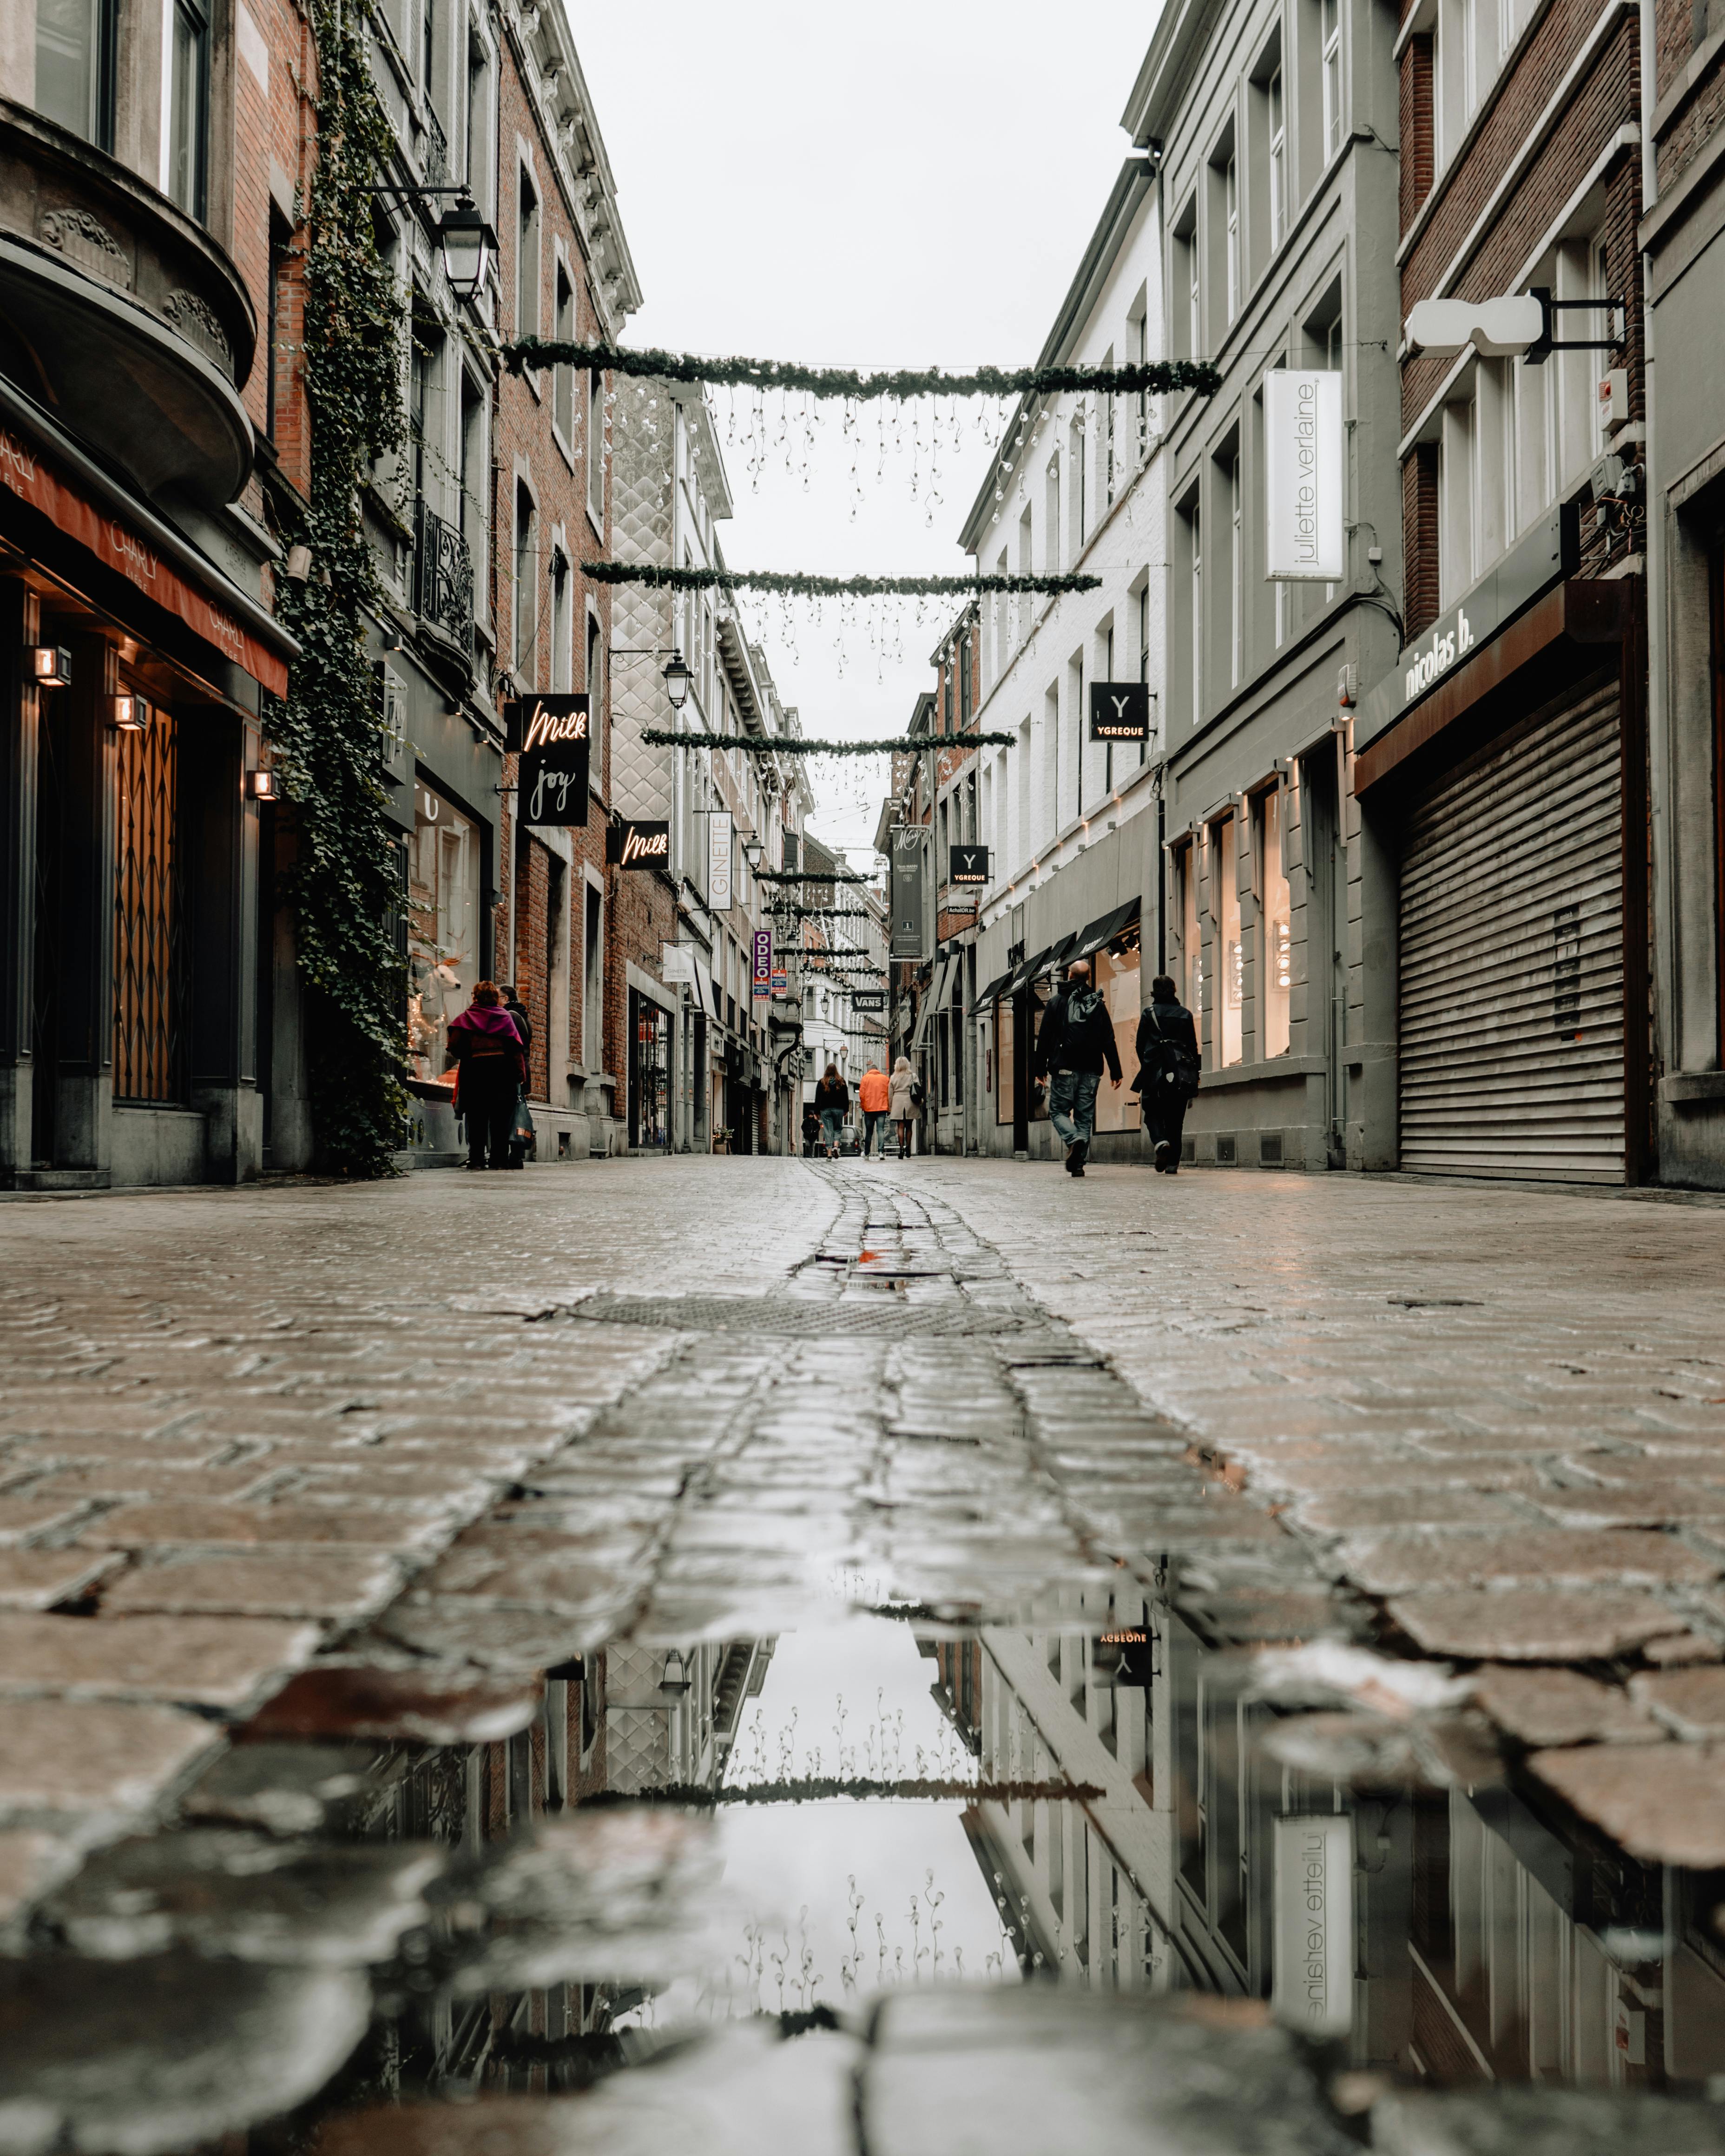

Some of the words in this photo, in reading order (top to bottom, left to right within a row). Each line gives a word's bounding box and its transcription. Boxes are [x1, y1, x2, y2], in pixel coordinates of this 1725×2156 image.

[1294, 384, 1314, 478] verlaine
[111, 520, 158, 580] CHARLY
[1294, 486, 1319, 565] juliette
[126, 567, 148, 594] LIEGE
[209, 601, 245, 650] CHARLY
[1406, 630, 1455, 701] nicolas
[1458, 608, 1474, 654] b.
[1097, 726, 1144, 736] YGREQUE
[1111, 696, 1130, 717] Y
[530, 759, 576, 820] joy
[712, 819, 728, 895] GINETTE
[963, 854, 976, 869] Y
[757, 933, 769, 978] ODEO
[855, 997, 881, 1007] VANS
